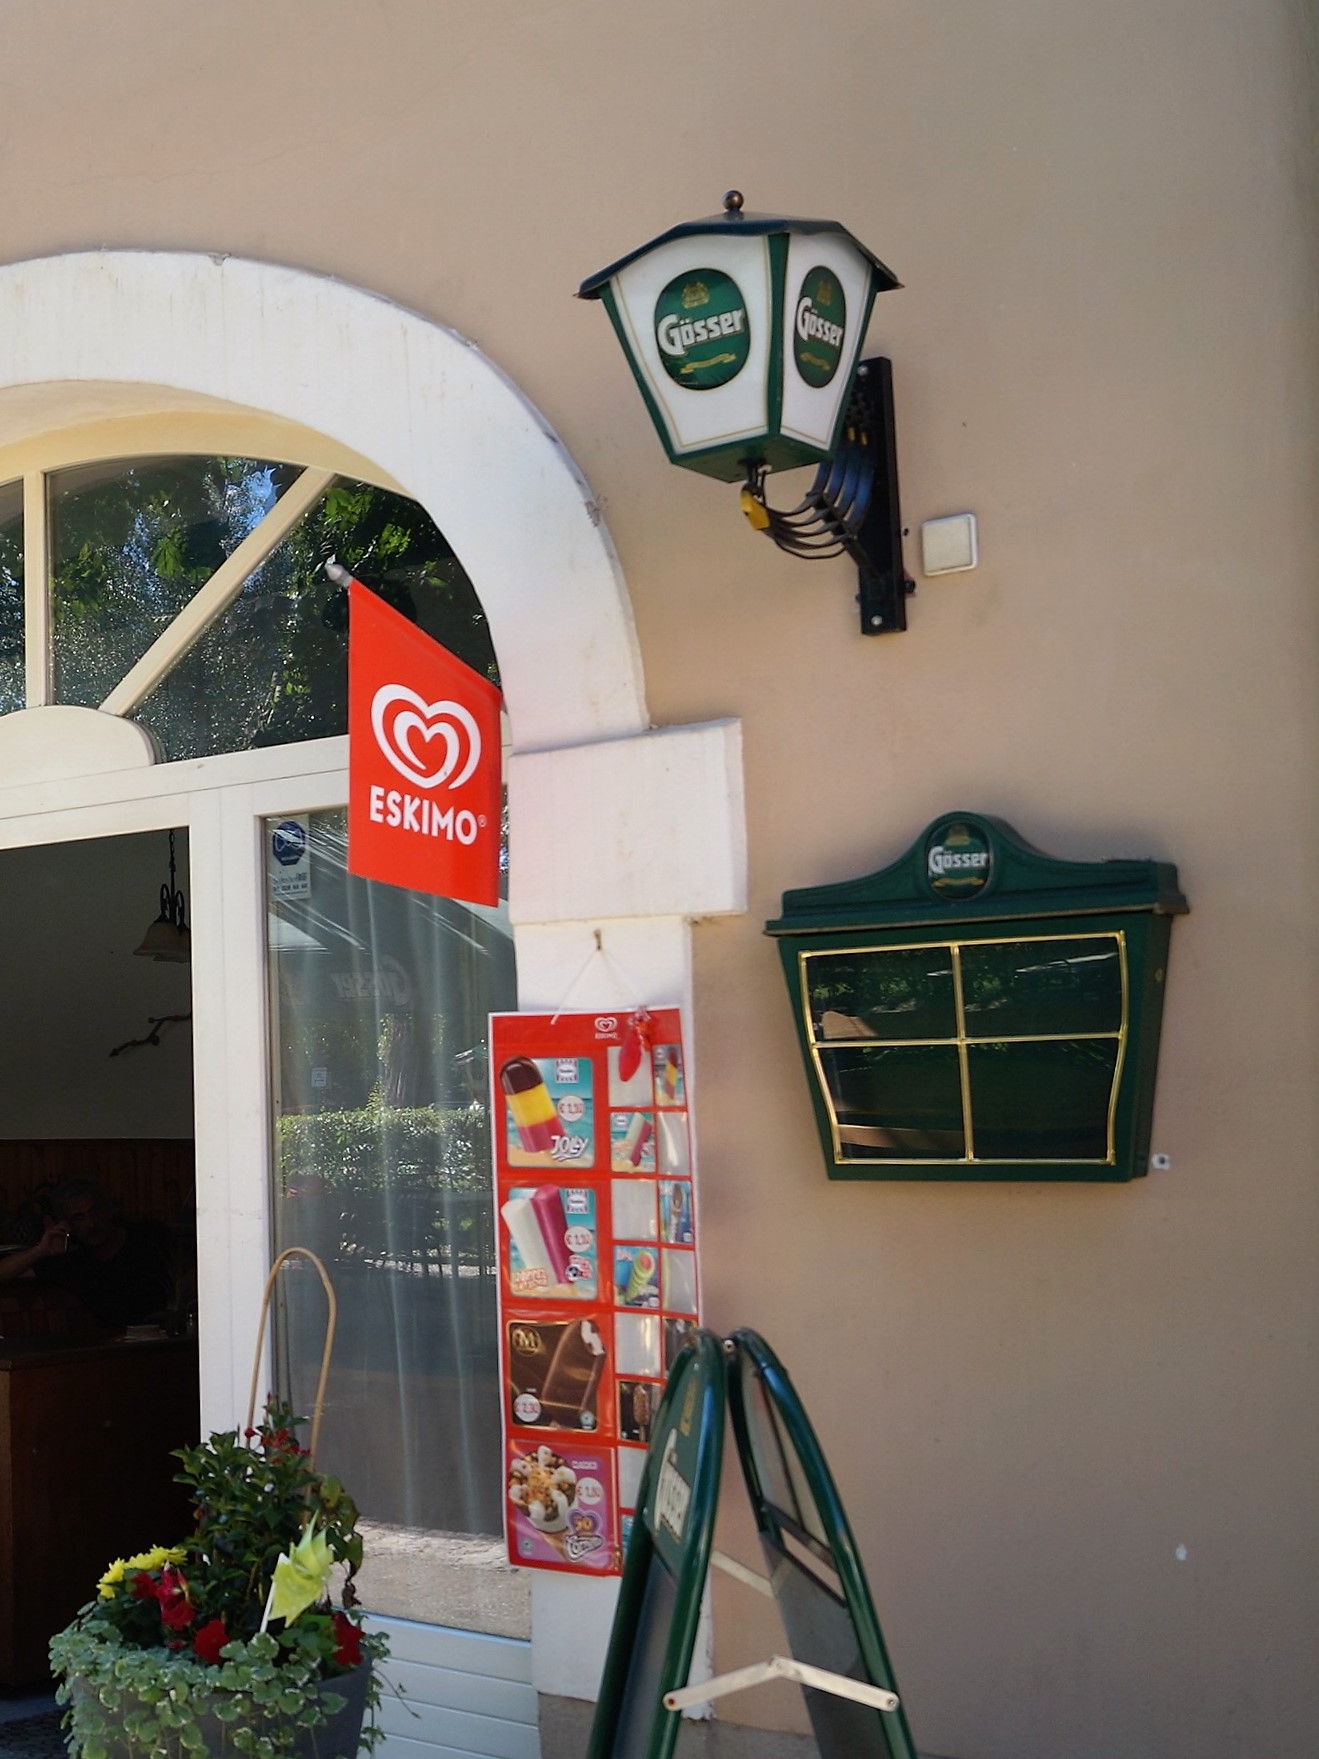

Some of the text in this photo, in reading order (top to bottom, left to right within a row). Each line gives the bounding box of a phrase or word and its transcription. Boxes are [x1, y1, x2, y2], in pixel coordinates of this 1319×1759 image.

[656, 307, 745, 357] Gösser
[796, 296, 843, 347] Gösser
[368, 784, 479, 846] ESKIMO
[928, 845, 989, 875] Gösser
